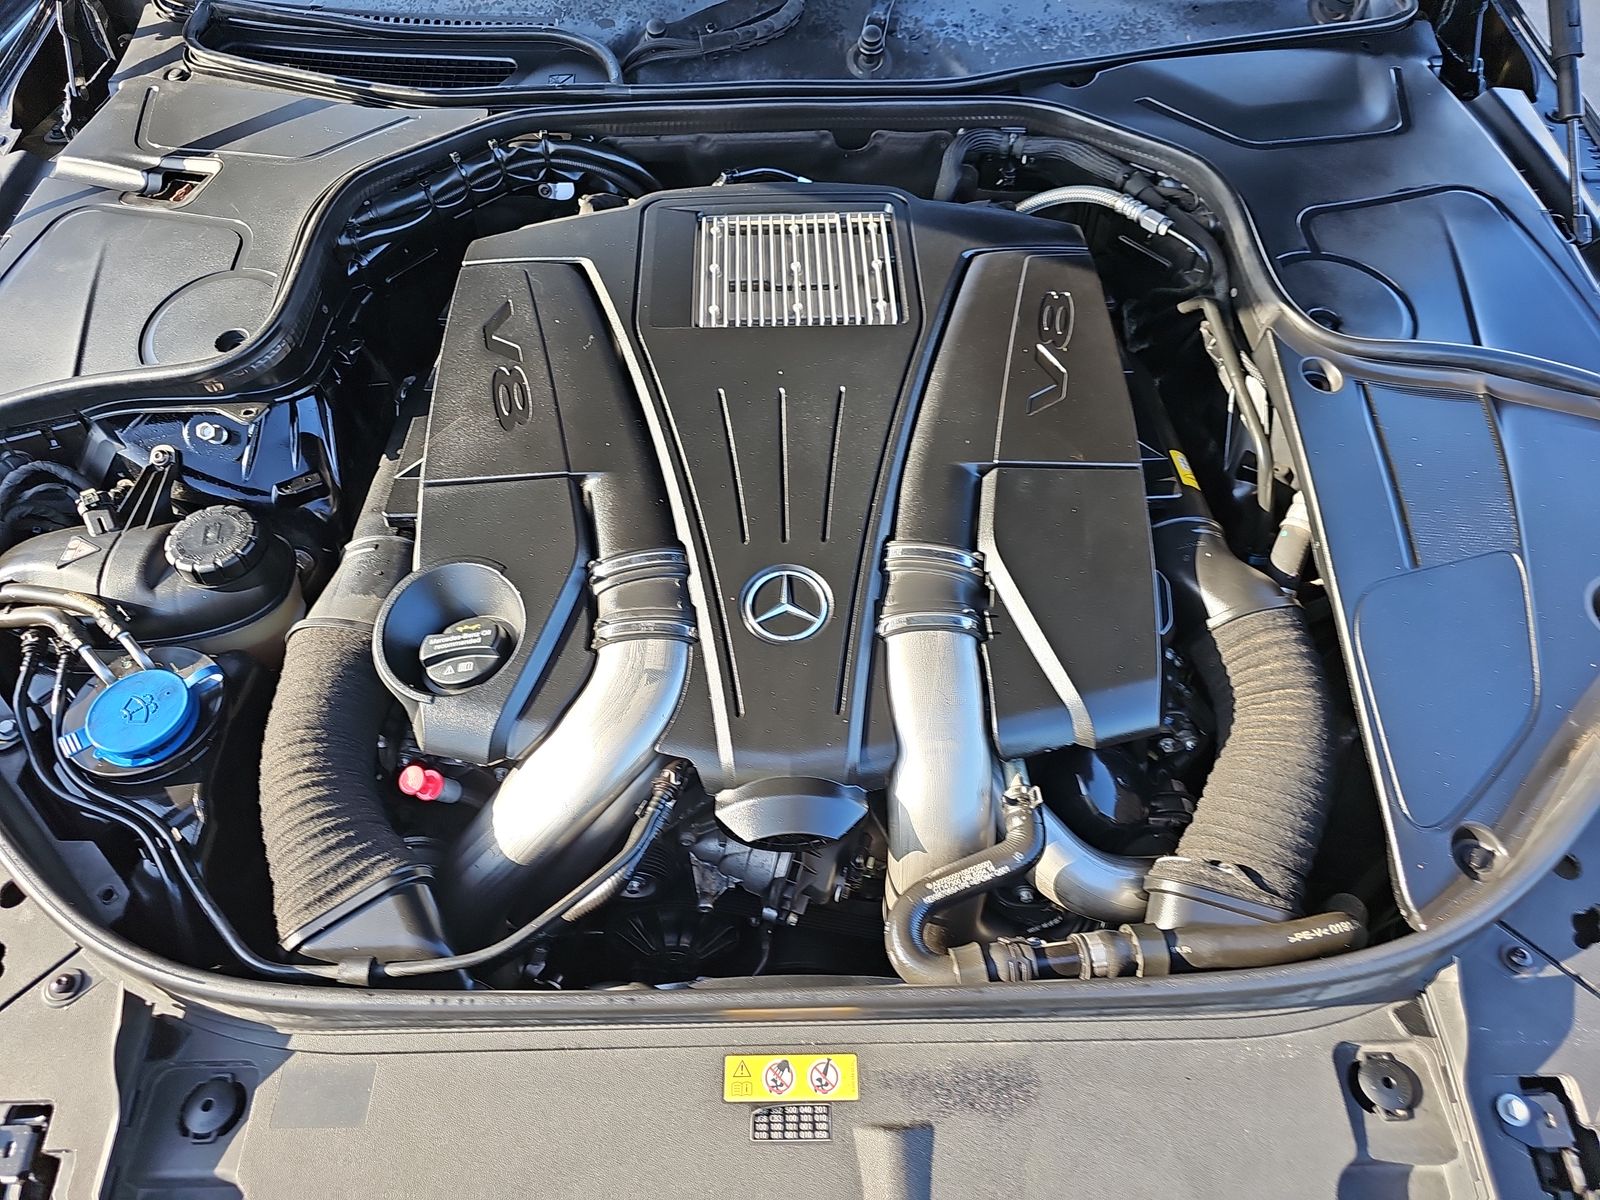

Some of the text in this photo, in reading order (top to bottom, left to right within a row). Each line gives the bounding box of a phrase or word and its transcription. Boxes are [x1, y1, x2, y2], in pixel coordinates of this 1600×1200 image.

[483, 299, 532, 431] V8
[1026, 291, 1075, 416] V8
[429, 631, 480, 645] Mercedes-Benz
[434, 637, 481, 650] recommended
